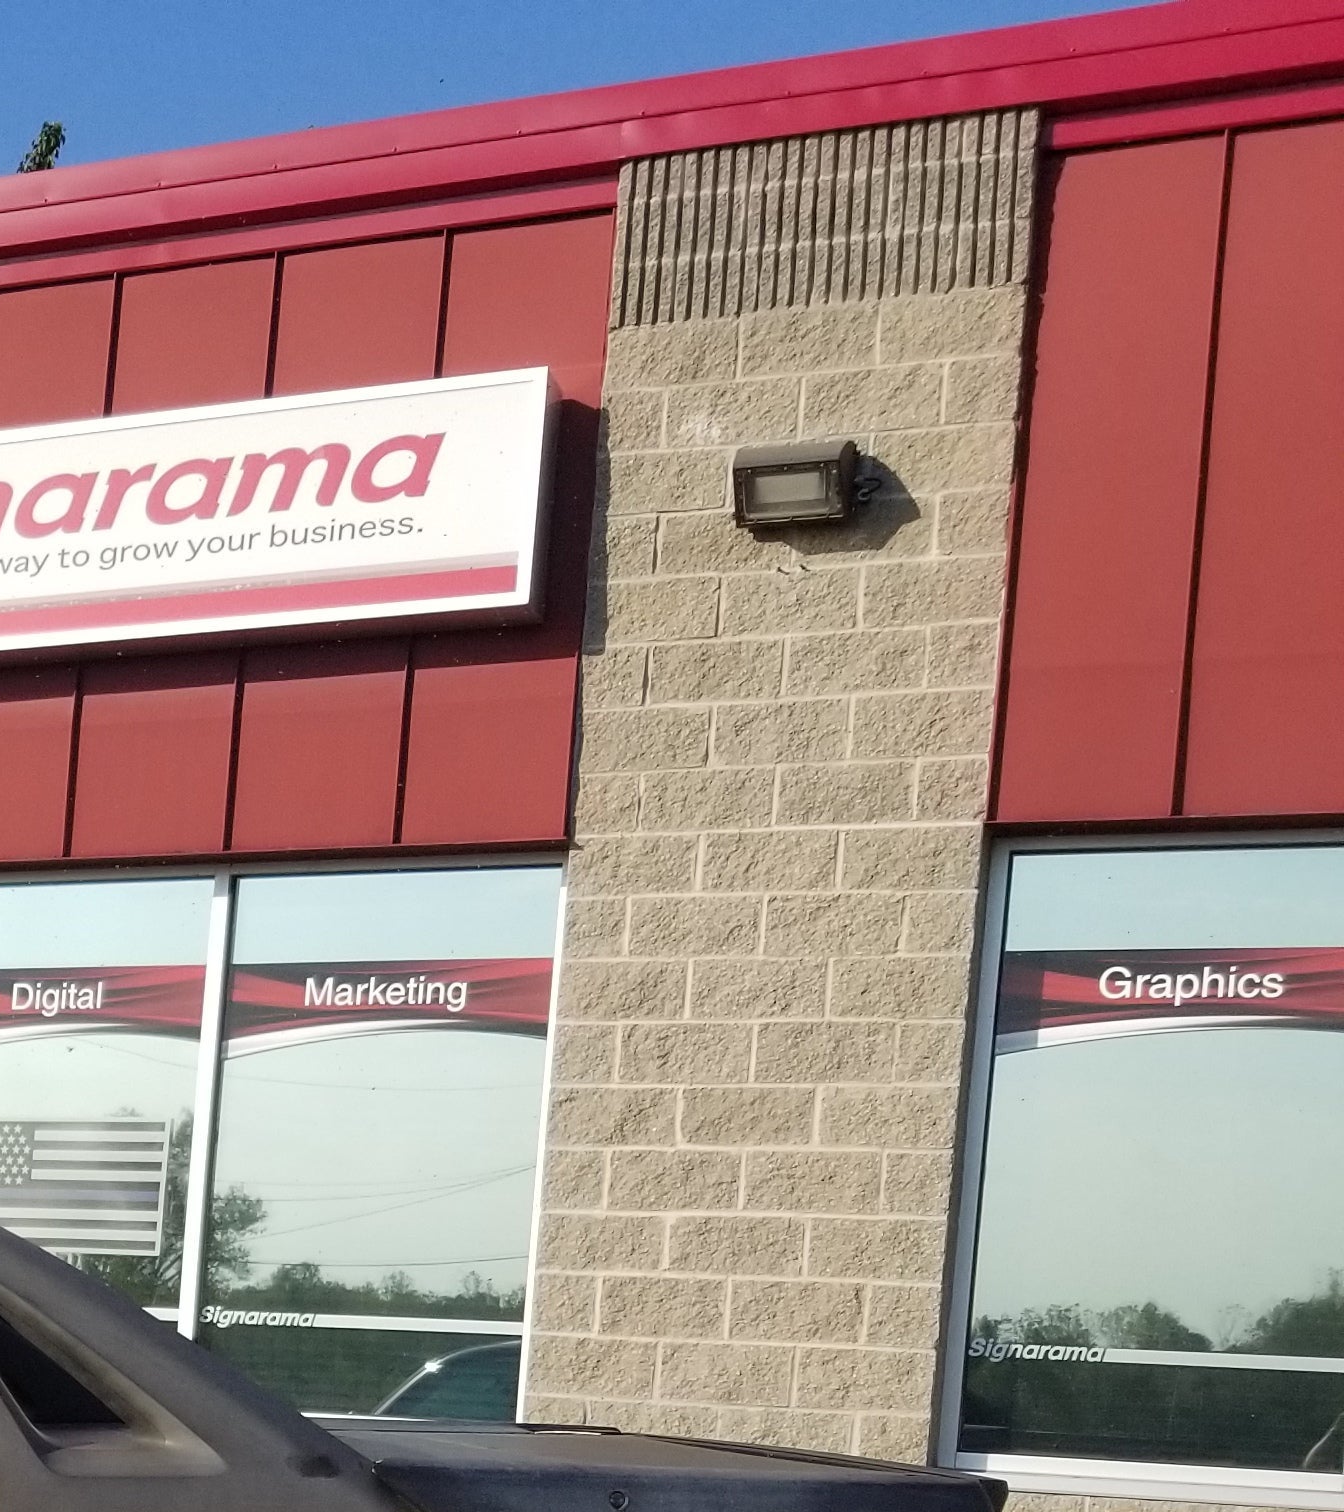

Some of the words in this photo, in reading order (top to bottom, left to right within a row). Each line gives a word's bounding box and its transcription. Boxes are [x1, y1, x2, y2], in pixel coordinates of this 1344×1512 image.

[58, 548, 91, 570] to
[99, 540, 179, 571] grow
[179, 531, 261, 562] your
[269, 515, 424, 548] business.
[10, 981, 104, 1017] Digital
[303, 976, 469, 1012] Marketing
[1097, 965, 1285, 1007] Graphics
[199, 1305, 315, 1329] Signarama
[967, 1337, 1108, 1365] Signarama
